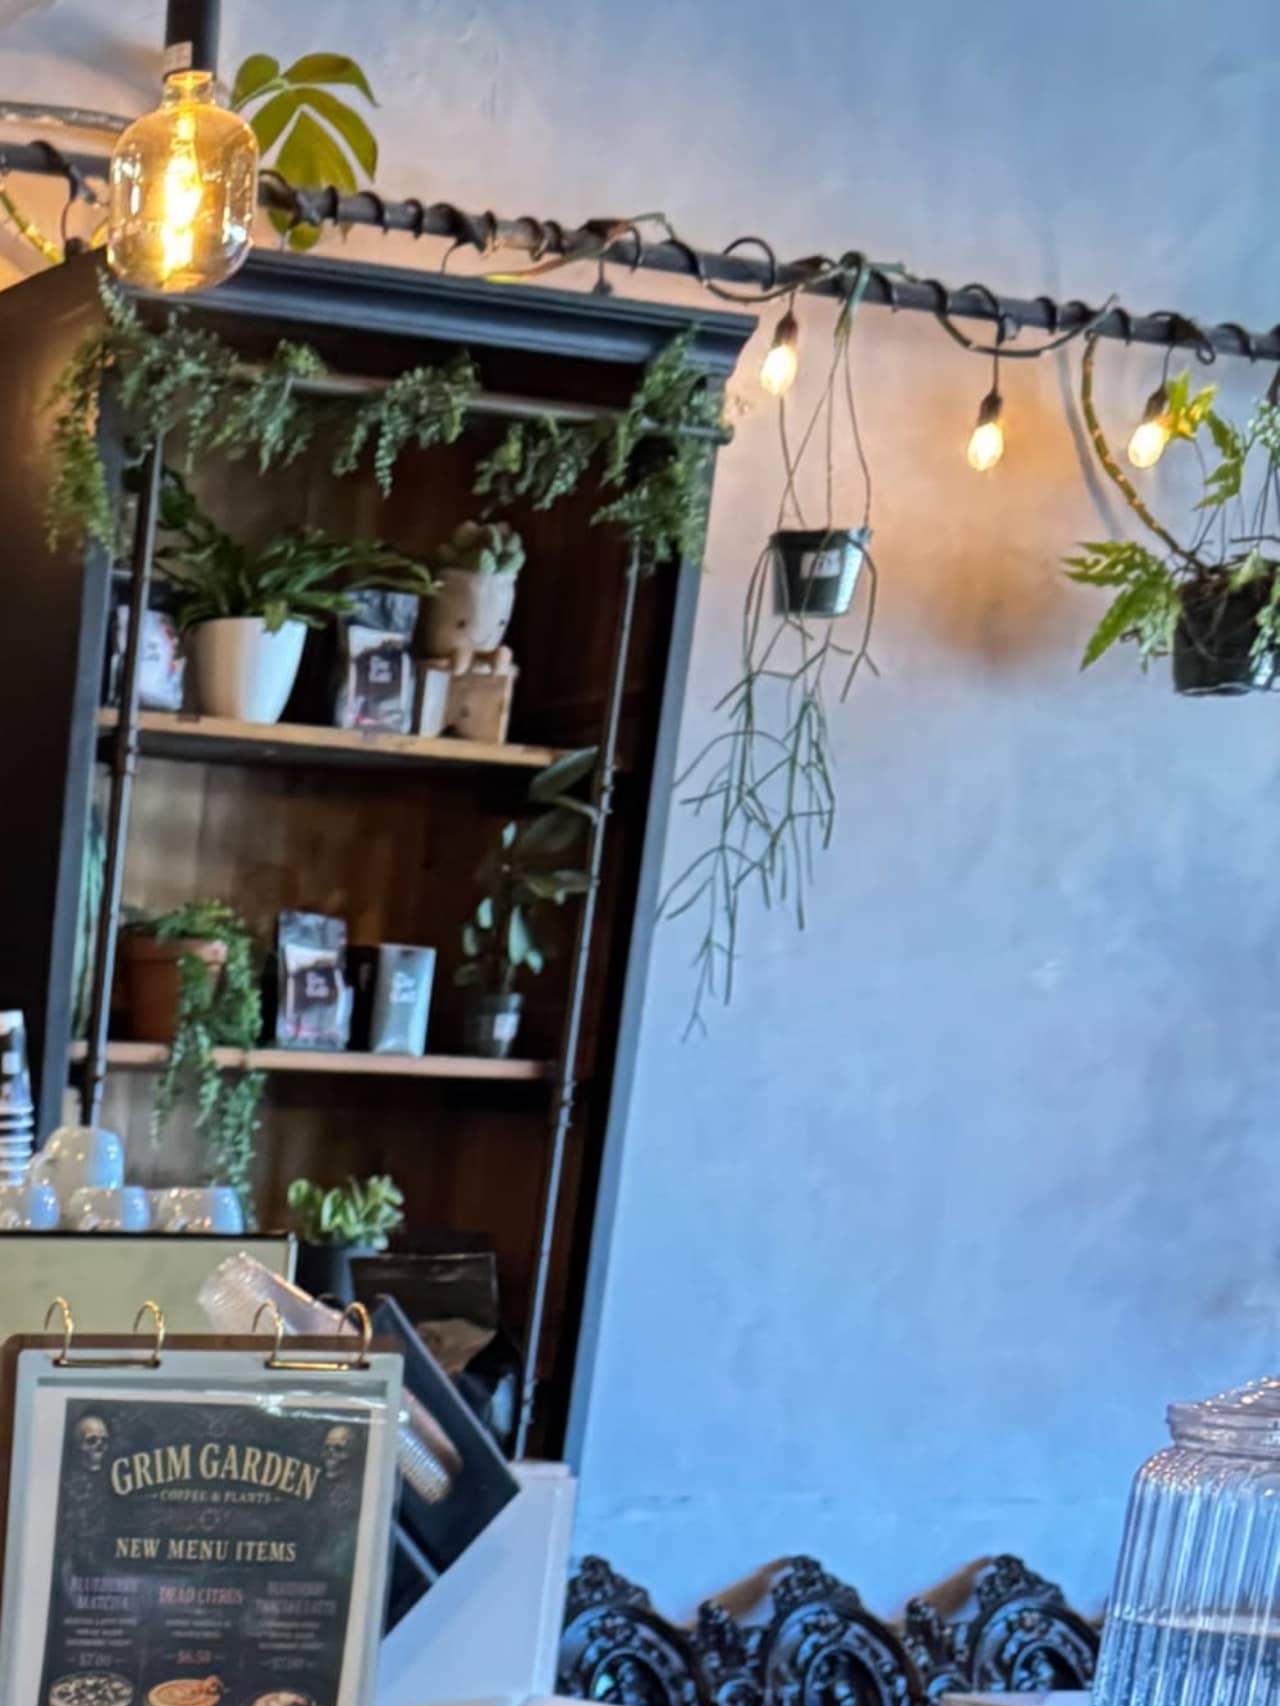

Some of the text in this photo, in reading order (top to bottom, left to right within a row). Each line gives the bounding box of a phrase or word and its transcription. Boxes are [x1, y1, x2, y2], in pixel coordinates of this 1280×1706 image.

[111, 1442, 321, 1500] GRIM GARDEN
[116, 1538, 296, 1562] NEW MENU ITEMS
